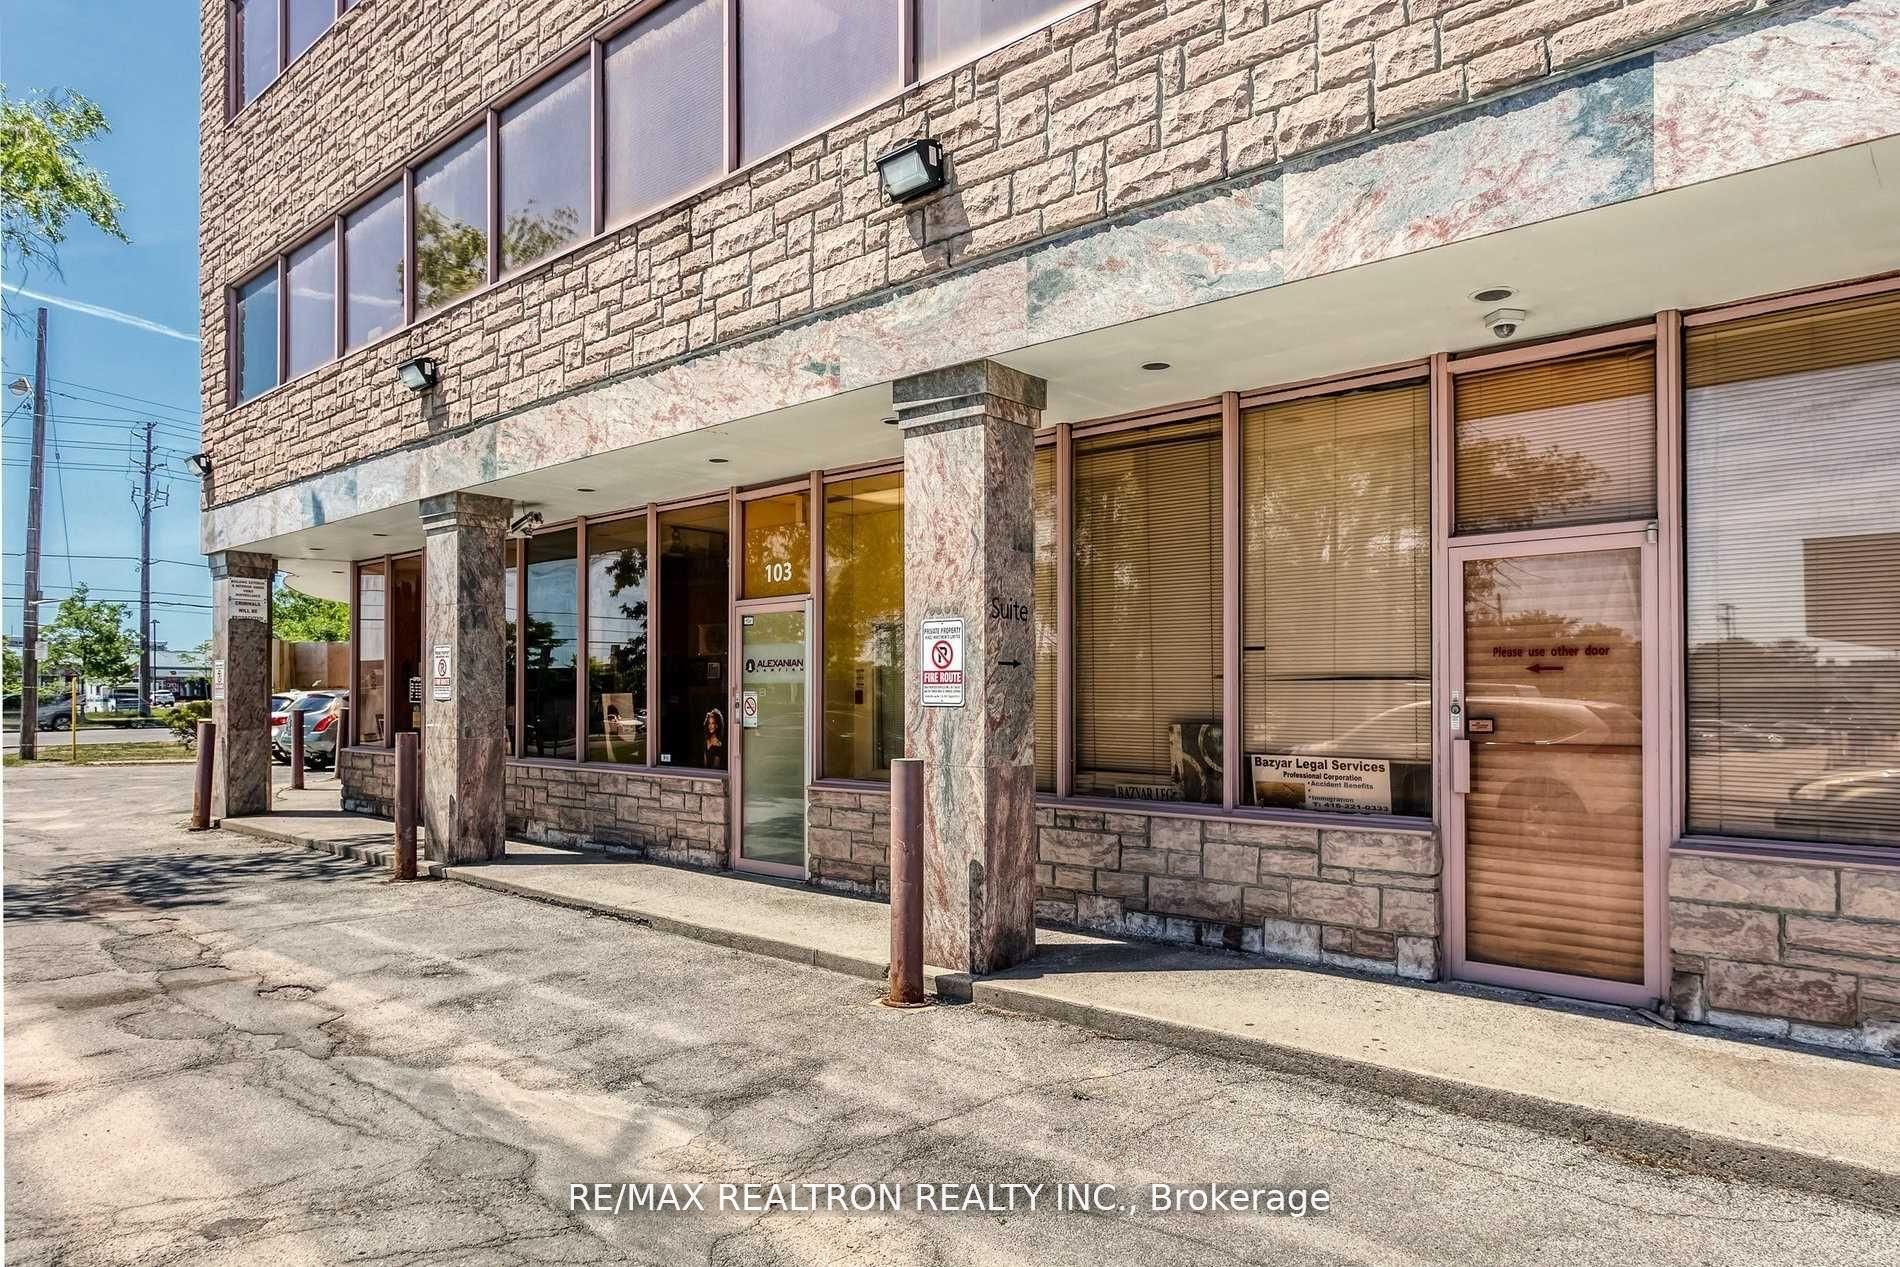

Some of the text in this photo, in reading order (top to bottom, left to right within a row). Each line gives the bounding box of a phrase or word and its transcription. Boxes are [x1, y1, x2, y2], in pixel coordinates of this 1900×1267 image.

[765, 562, 792, 582] 103
[992, 597, 1028, 621] Suite
[940, 626, 961, 634] PROPERTY
[1493, 645, 1610, 657] Please use other door
[757, 659, 804, 667] ALEXANIAN
[924, 672, 961, 683] FIRE ROUTE
[1254, 757, 1386, 772] Bazyar Legal Services
[1283, 771, 1362, 782] Professional Corporation
